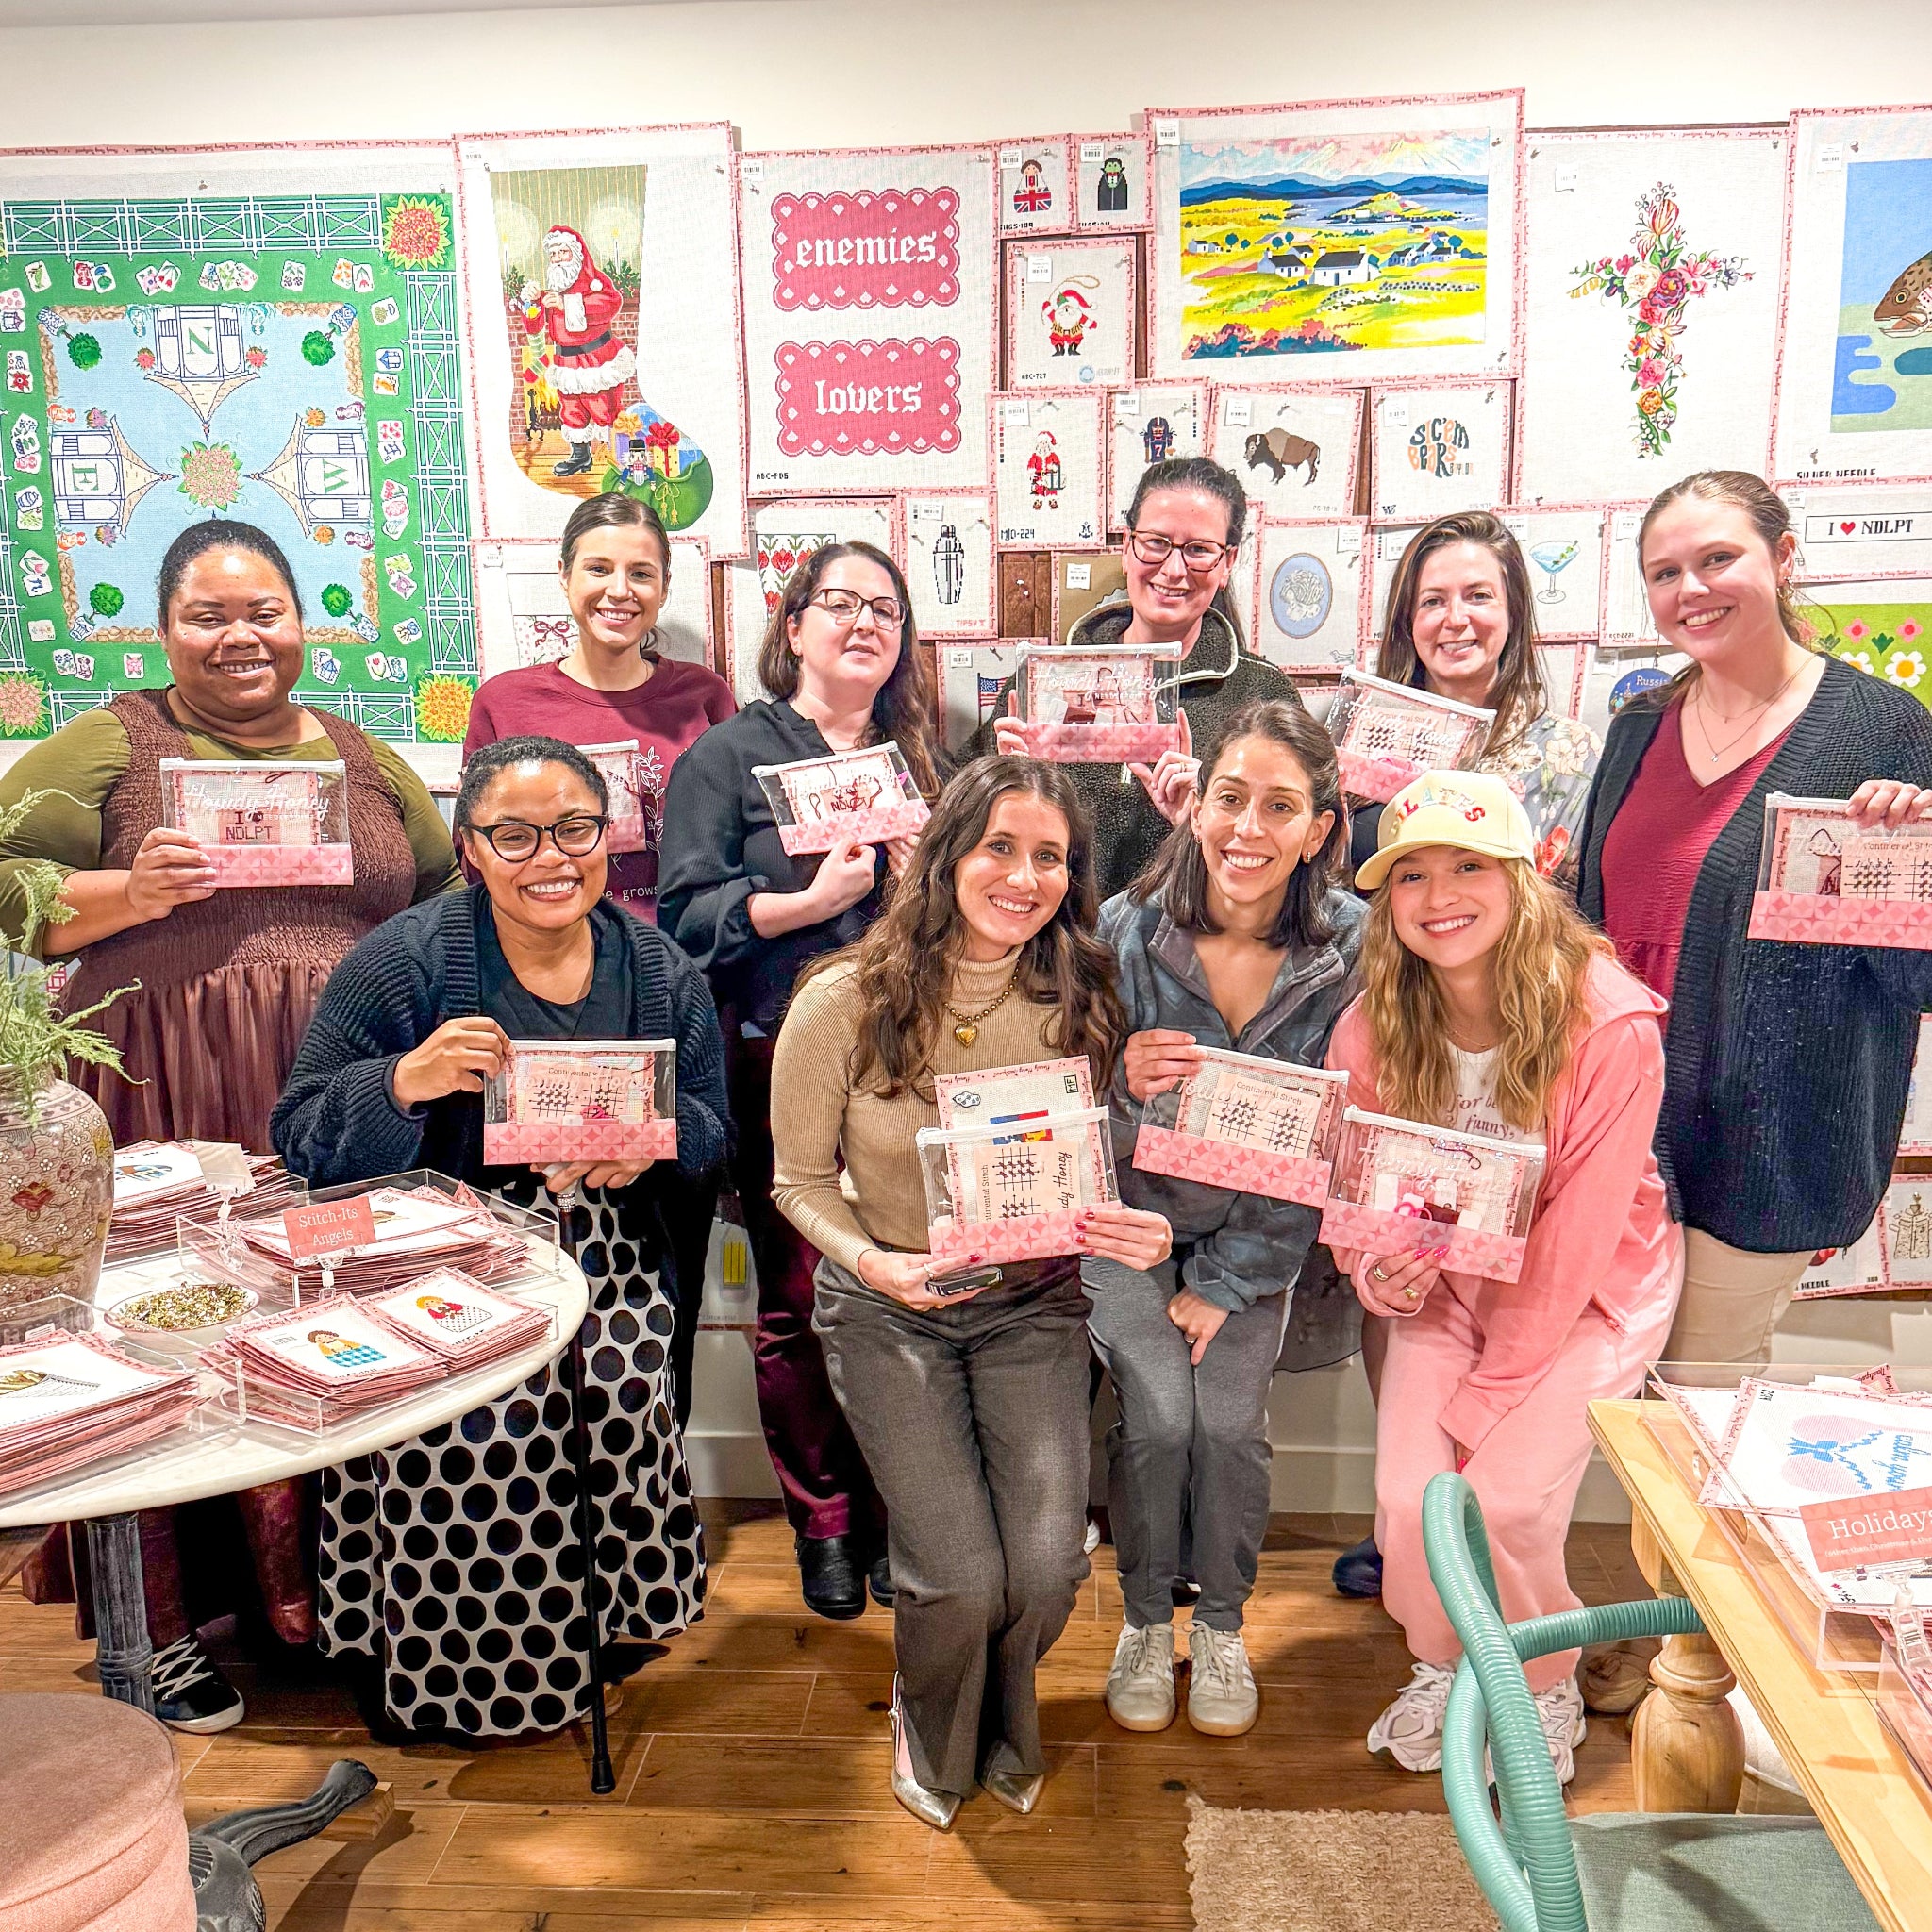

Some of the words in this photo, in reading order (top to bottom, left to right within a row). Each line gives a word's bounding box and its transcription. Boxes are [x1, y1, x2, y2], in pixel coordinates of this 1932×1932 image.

[796, 227, 937, 267] enemies
[185, 327, 214, 354] N
[815, 379, 923, 415] lovers
[1154, 444, 1163, 457] 7
[72, 463, 99, 491] E
[1827, 523, 1835, 536] I
[1861, 519, 1914, 536] NDLPT
[956, 619, 977, 627] TIPSY
[263, 783, 330, 823] Honey
[226, 825, 274, 841] NDLPT
[623, 885, 658, 903] grows
[1465, 1114, 1515, 1140] funny,
[981, 1164, 990, 1191] Stitch
[1052, 1150, 1073, 1191] Honey
[298, 1207, 358, 1229] Stitch-Its
[312, 1227, 355, 1247] Angels
